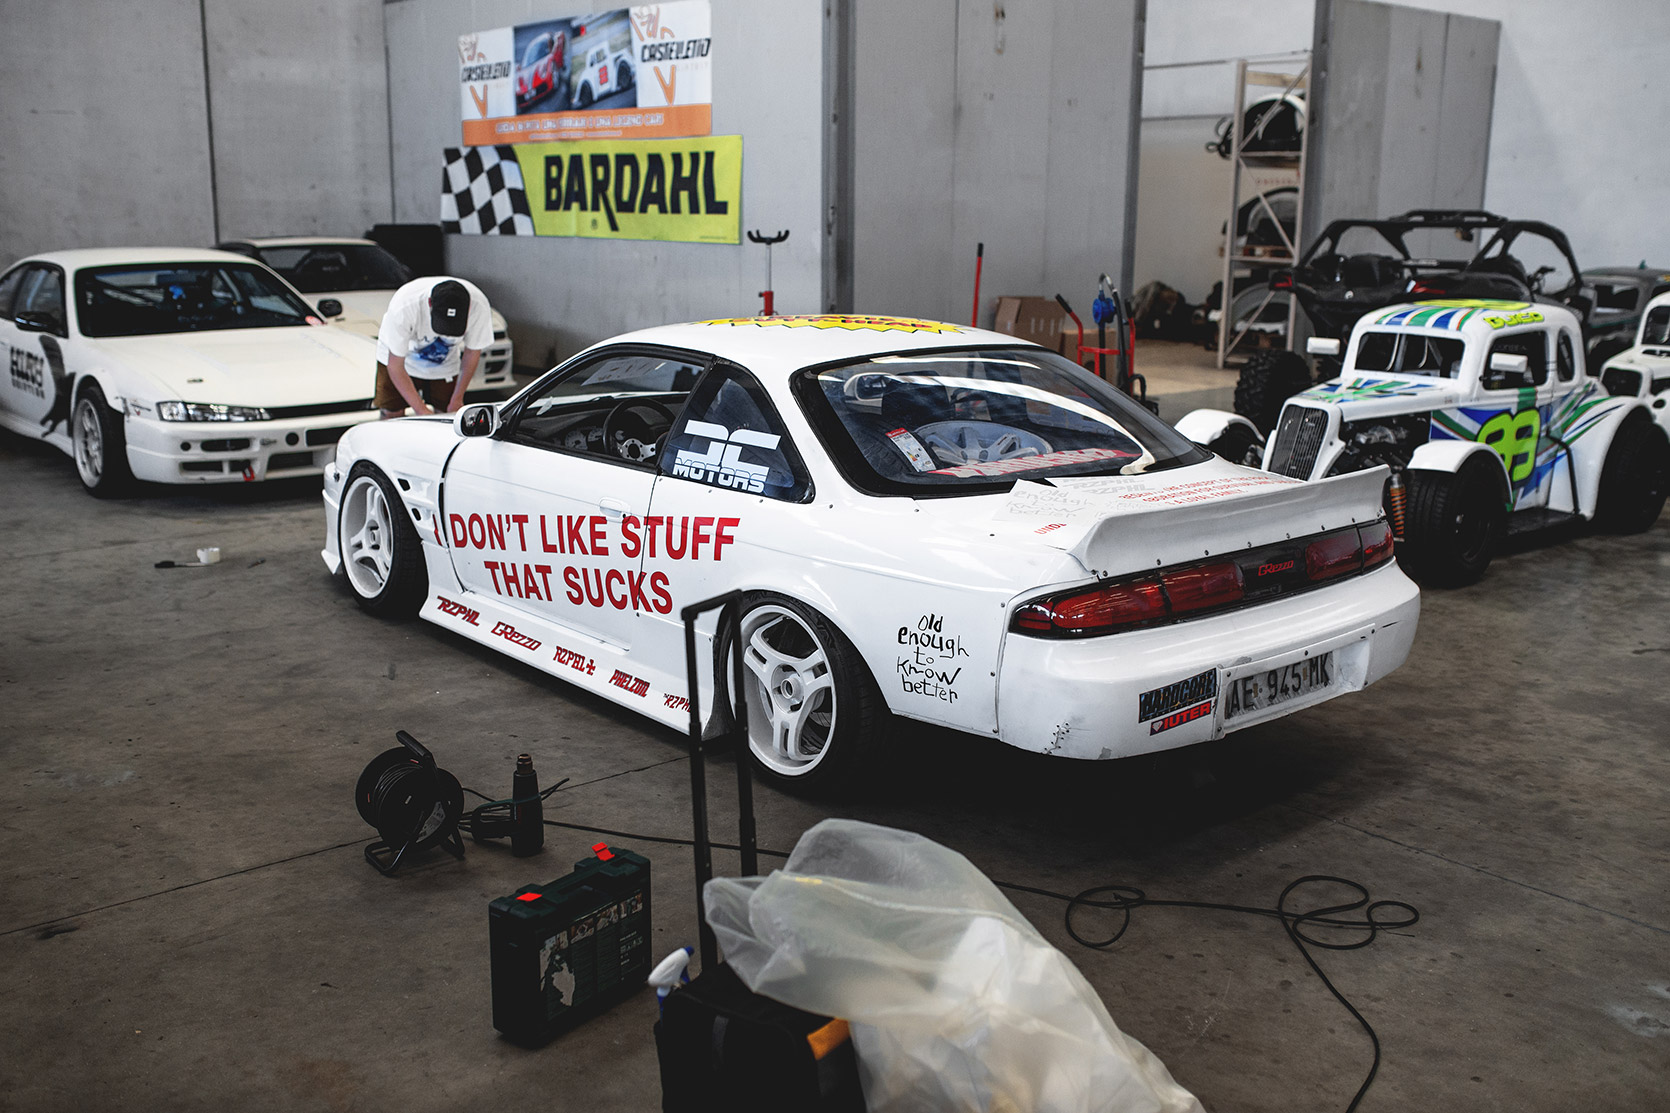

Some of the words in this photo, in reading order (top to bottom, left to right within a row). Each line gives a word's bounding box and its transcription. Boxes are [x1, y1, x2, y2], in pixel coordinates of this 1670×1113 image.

[544, 151, 728, 232] BARDAHL
[672, 457, 767, 493] MOTORS
[449, 513, 529, 552] DON'T
[540, 515, 610, 556] LIKE
[620, 515, 741, 561] STUFF
[484, 561, 552, 602] THAT
[563, 566, 673, 615] SUCKS
[918, 613, 943, 633] Old
[897, 626, 969, 659] enough
[913, 646, 935, 666] to
[902, 673, 958, 703] better
[1229, 677, 1255, 716] AE
[1267, 666, 1301, 701] 945
[1310, 653, 1332, 687] MK
[1163, 702, 1212, 729] IUTER
